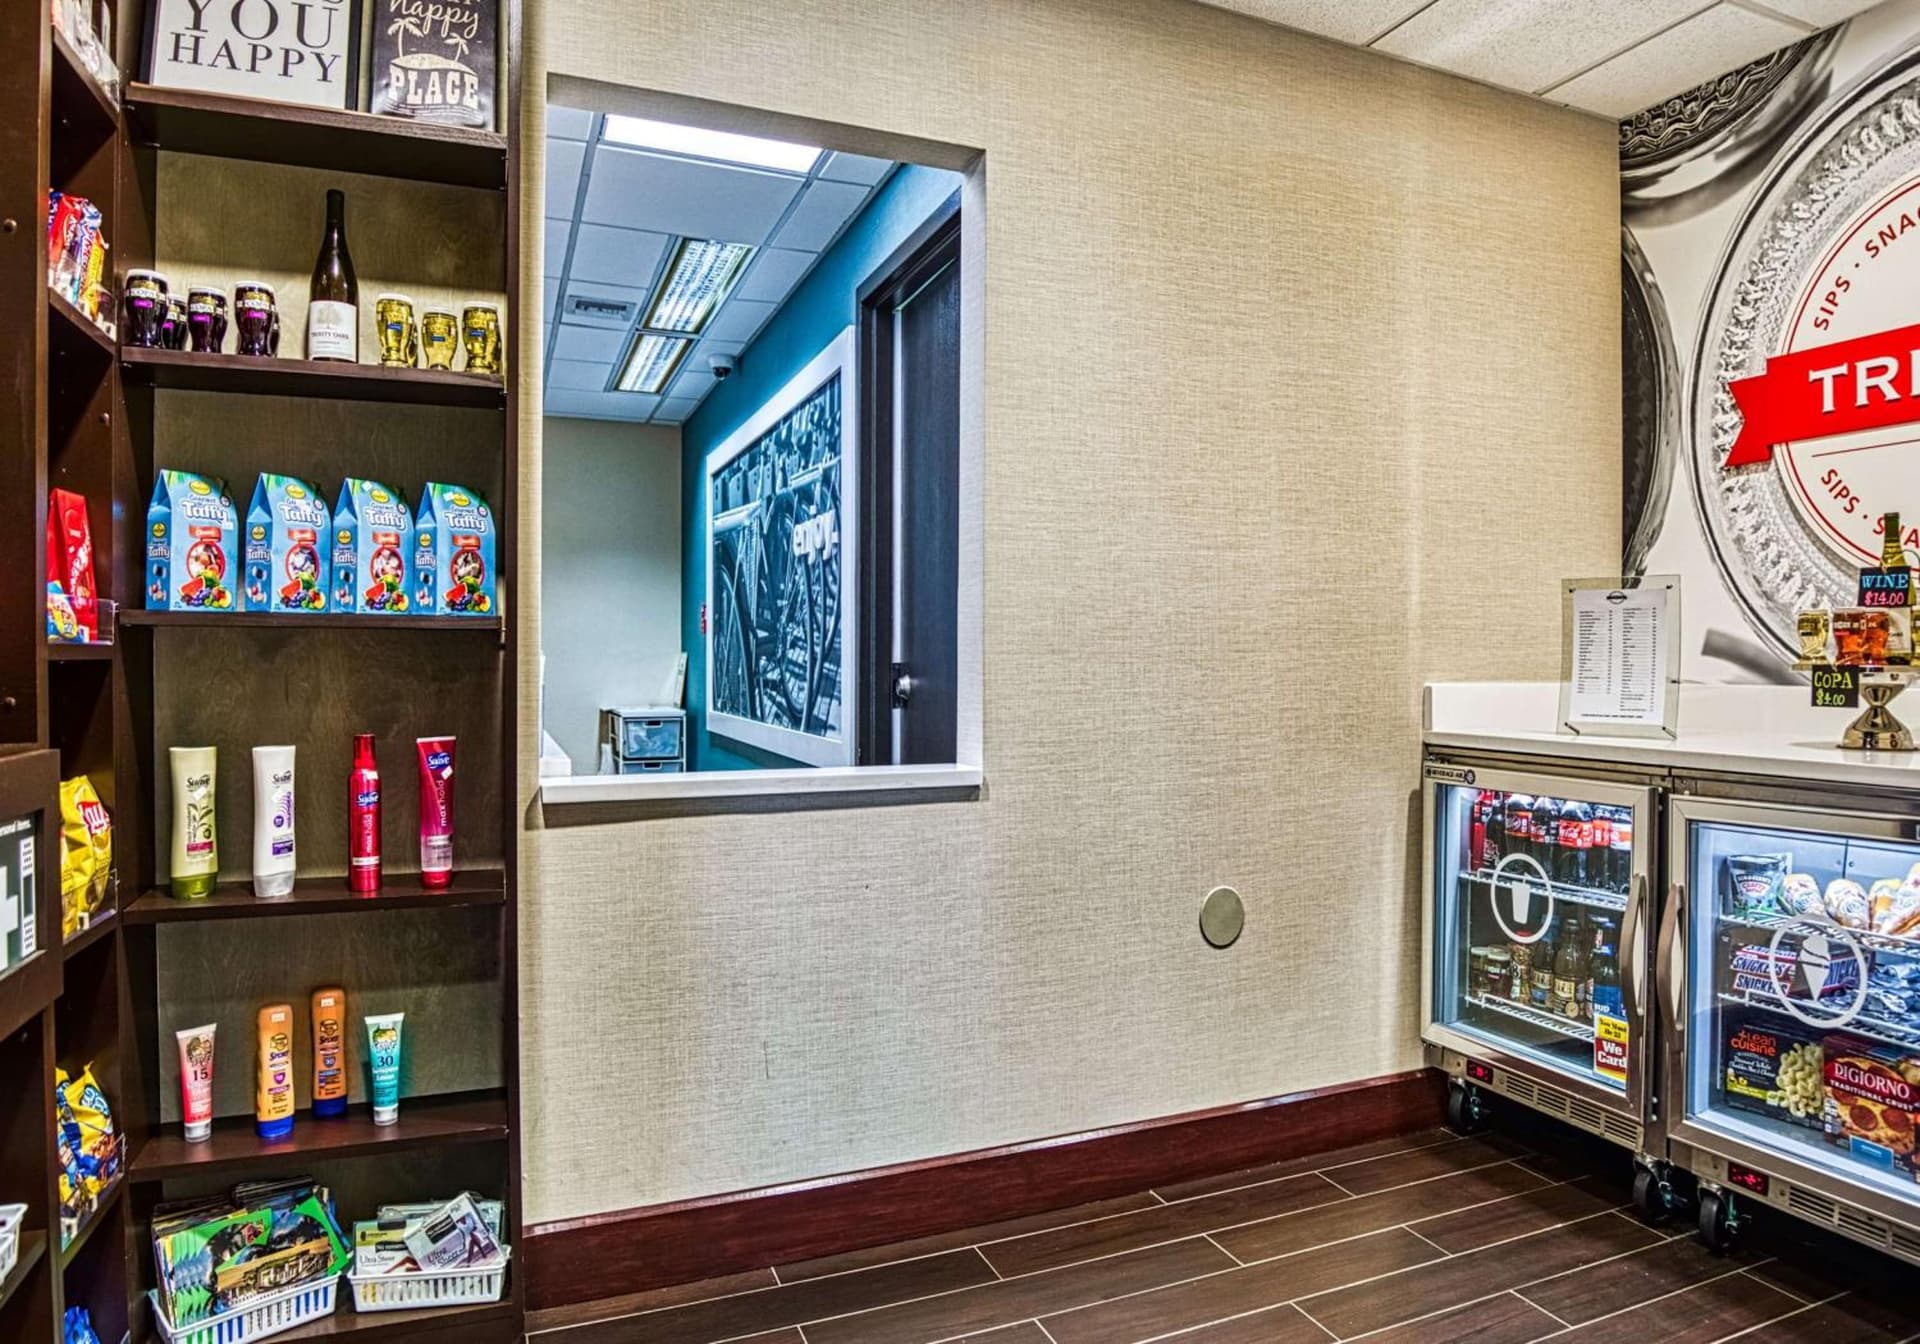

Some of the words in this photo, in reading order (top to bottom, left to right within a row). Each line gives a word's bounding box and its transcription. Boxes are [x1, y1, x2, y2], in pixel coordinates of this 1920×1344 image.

[184, 0, 340, 49] YOU
[168, 31, 341, 83] HAPPY
[388, 64, 479, 111] PLACE
[1813, 275, 1851, 331] SIPS
[1864, 207, 1920, 259] SNA
[181, 501, 229, 526] Taffy
[280, 504, 323, 528] Taffy
[1821, 468, 1860, 514] SIPS
[1873, 516, 1920, 549] SA
[366, 509, 407, 531] Taffy
[444, 512, 487, 533] Taffy
[149, 546, 170, 560] Taffy
[248, 549, 271, 563] Taffy
[333, 552, 357, 567] Taffy
[415, 554, 437, 568] Taffy
[1861, 574, 1909, 589] WINE
[1864, 591, 1905, 606] $14.00
[1815, 688, 1846, 706] $4.00
[427, 752, 451, 767] Suave
[186, 774, 211, 788] Suave
[272, 770, 292, 784] Suave
[440, 804, 448, 827] max
[1602, 1040, 1623, 1056] We
[1731, 1038, 1777, 1057] cuisine
[1747, 1032, 1777, 1048] lean
[376, 1055, 395, 1068] 30
[1597, 1050, 1628, 1068] Card
[193, 1068, 209, 1082] 15
[1830, 1079, 1883, 1103] TRADITIONAL
[1885, 1097, 1914, 1113] CRUST
